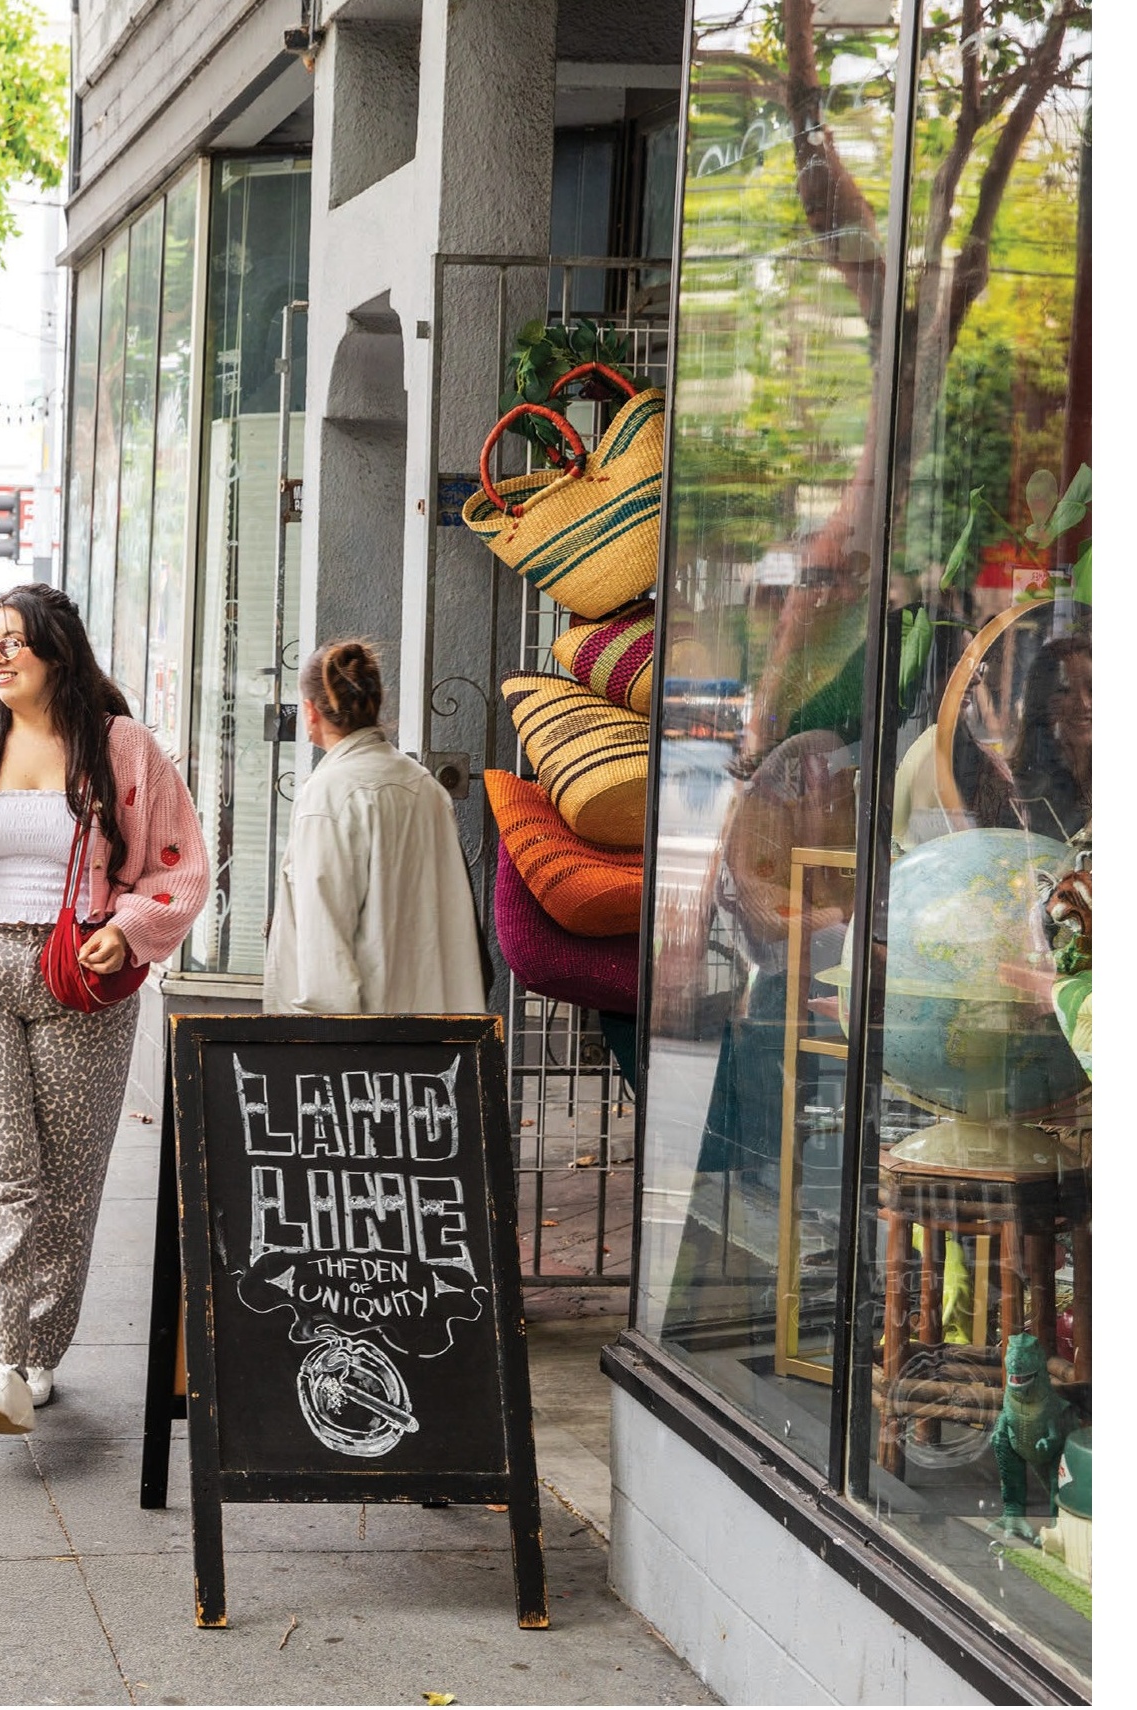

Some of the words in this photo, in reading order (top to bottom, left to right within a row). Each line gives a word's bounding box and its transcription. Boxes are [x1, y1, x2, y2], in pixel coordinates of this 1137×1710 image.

[233, 1052, 461, 1161] LAND
[250, 1166, 478, 1283] LINE
[307, 1255, 360, 1279] THE
[360, 1257, 408, 1284] DEN
[349, 1281, 373, 1295] OF
[298, 1285, 428, 1323] UNIQUITY
